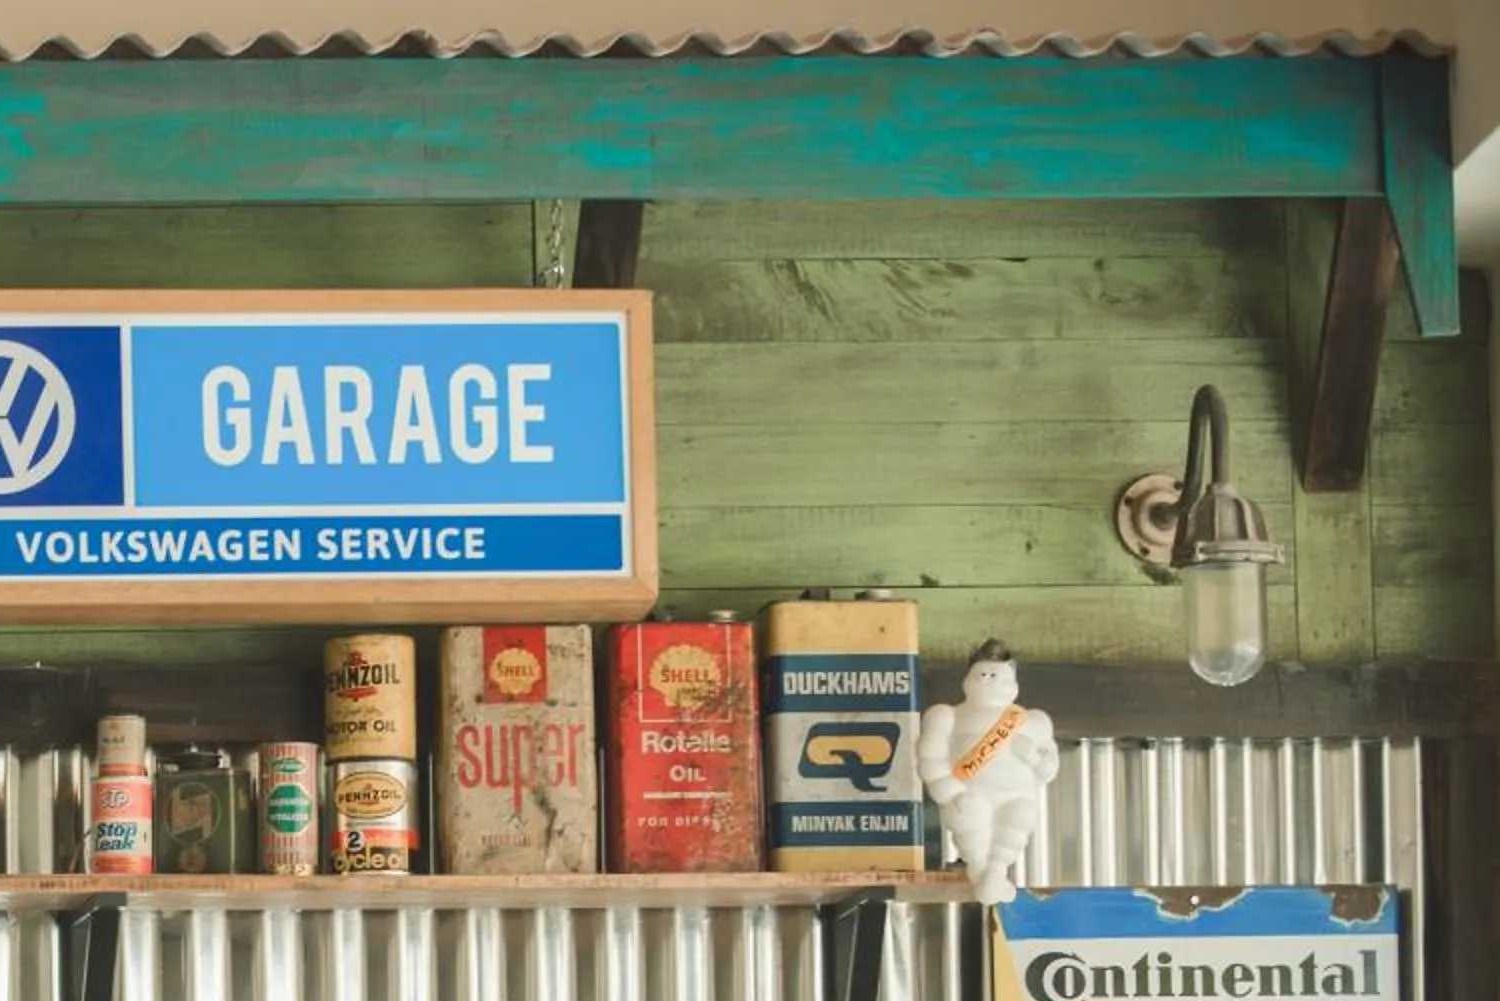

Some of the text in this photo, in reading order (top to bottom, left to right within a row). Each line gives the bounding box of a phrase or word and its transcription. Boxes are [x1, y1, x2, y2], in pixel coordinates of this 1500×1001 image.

[202, 363, 555, 468] GARAGE
[15, 526, 487, 564] VOLKSWAGEN SERVICE
[325, 664, 400, 693] ENNZOIL
[497, 664, 535, 678] SHELL
[660, 667, 712, 684] SHELL
[783, 671, 911, 695] DUCKHAMS
[456, 722, 585, 816] super
[669, 765, 708, 783] OIL
[337, 788, 403, 804] PENNZOIL
[791, 814, 910, 833] MINYAK ENJIN
[346, 831, 361, 849] 2
